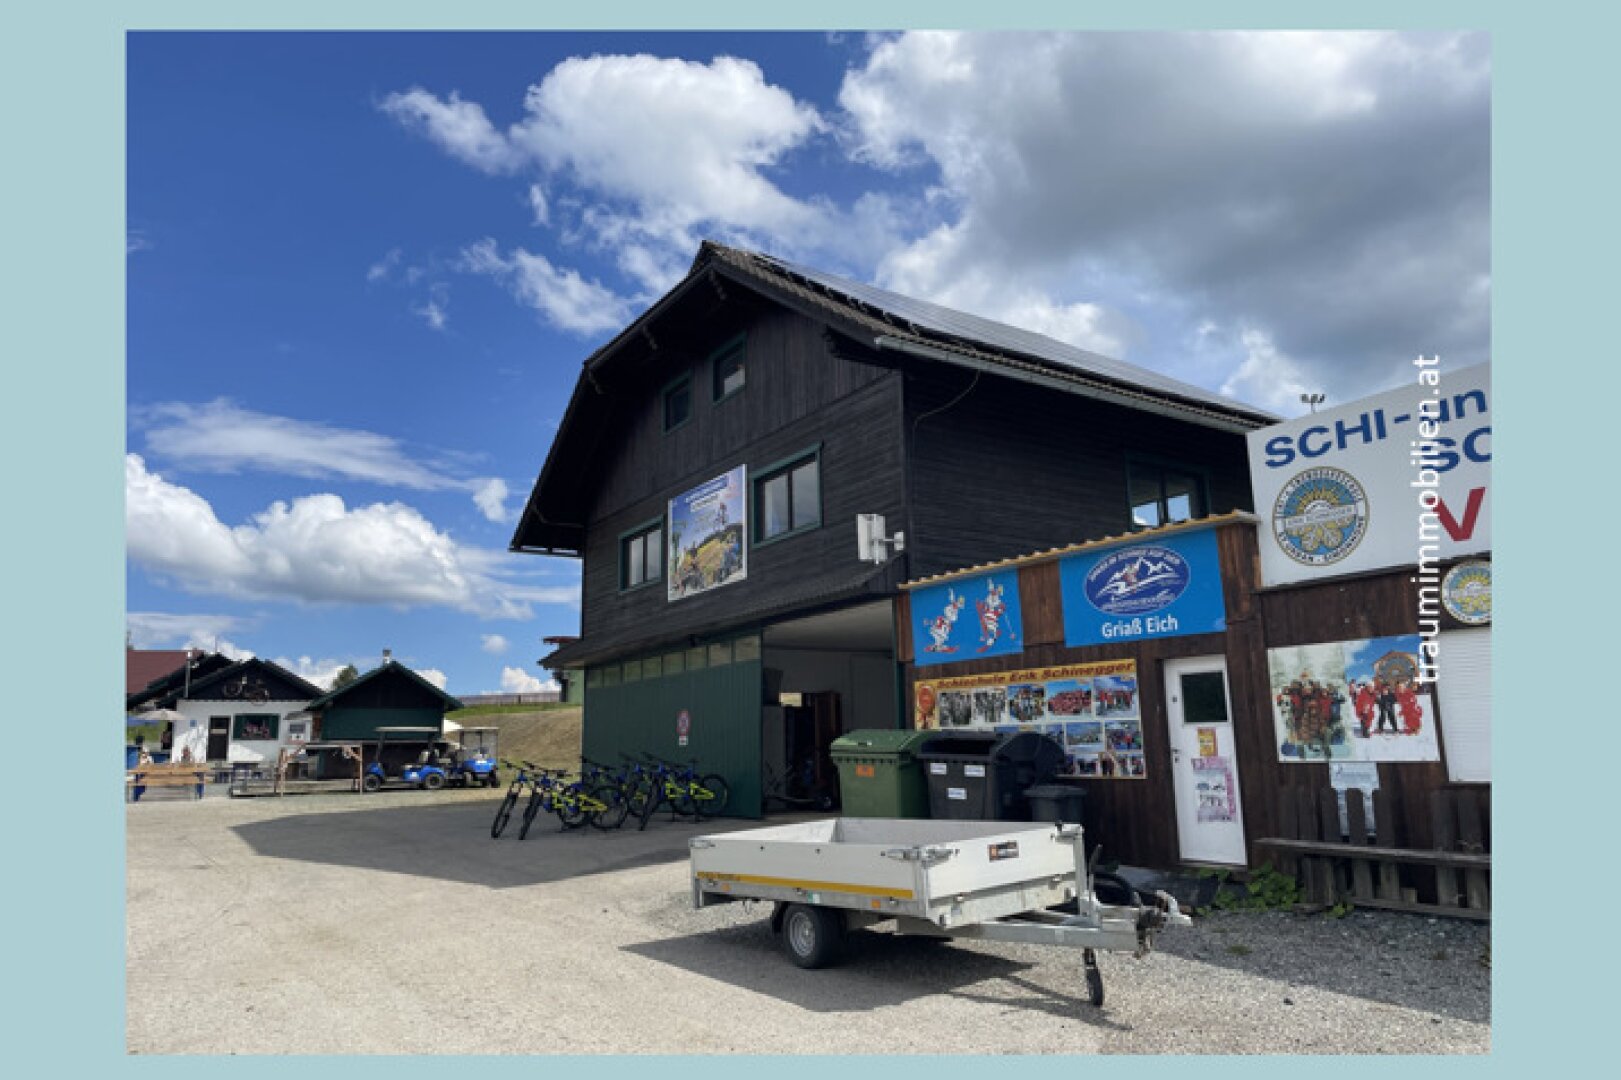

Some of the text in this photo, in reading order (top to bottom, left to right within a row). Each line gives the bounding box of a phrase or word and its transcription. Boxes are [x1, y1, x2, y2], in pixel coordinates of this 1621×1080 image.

[1102, 614, 1178, 638] Griaß Eich
[1010, 671, 1037, 682] Erik
[1043, 662, 1133, 680] Schinegger
